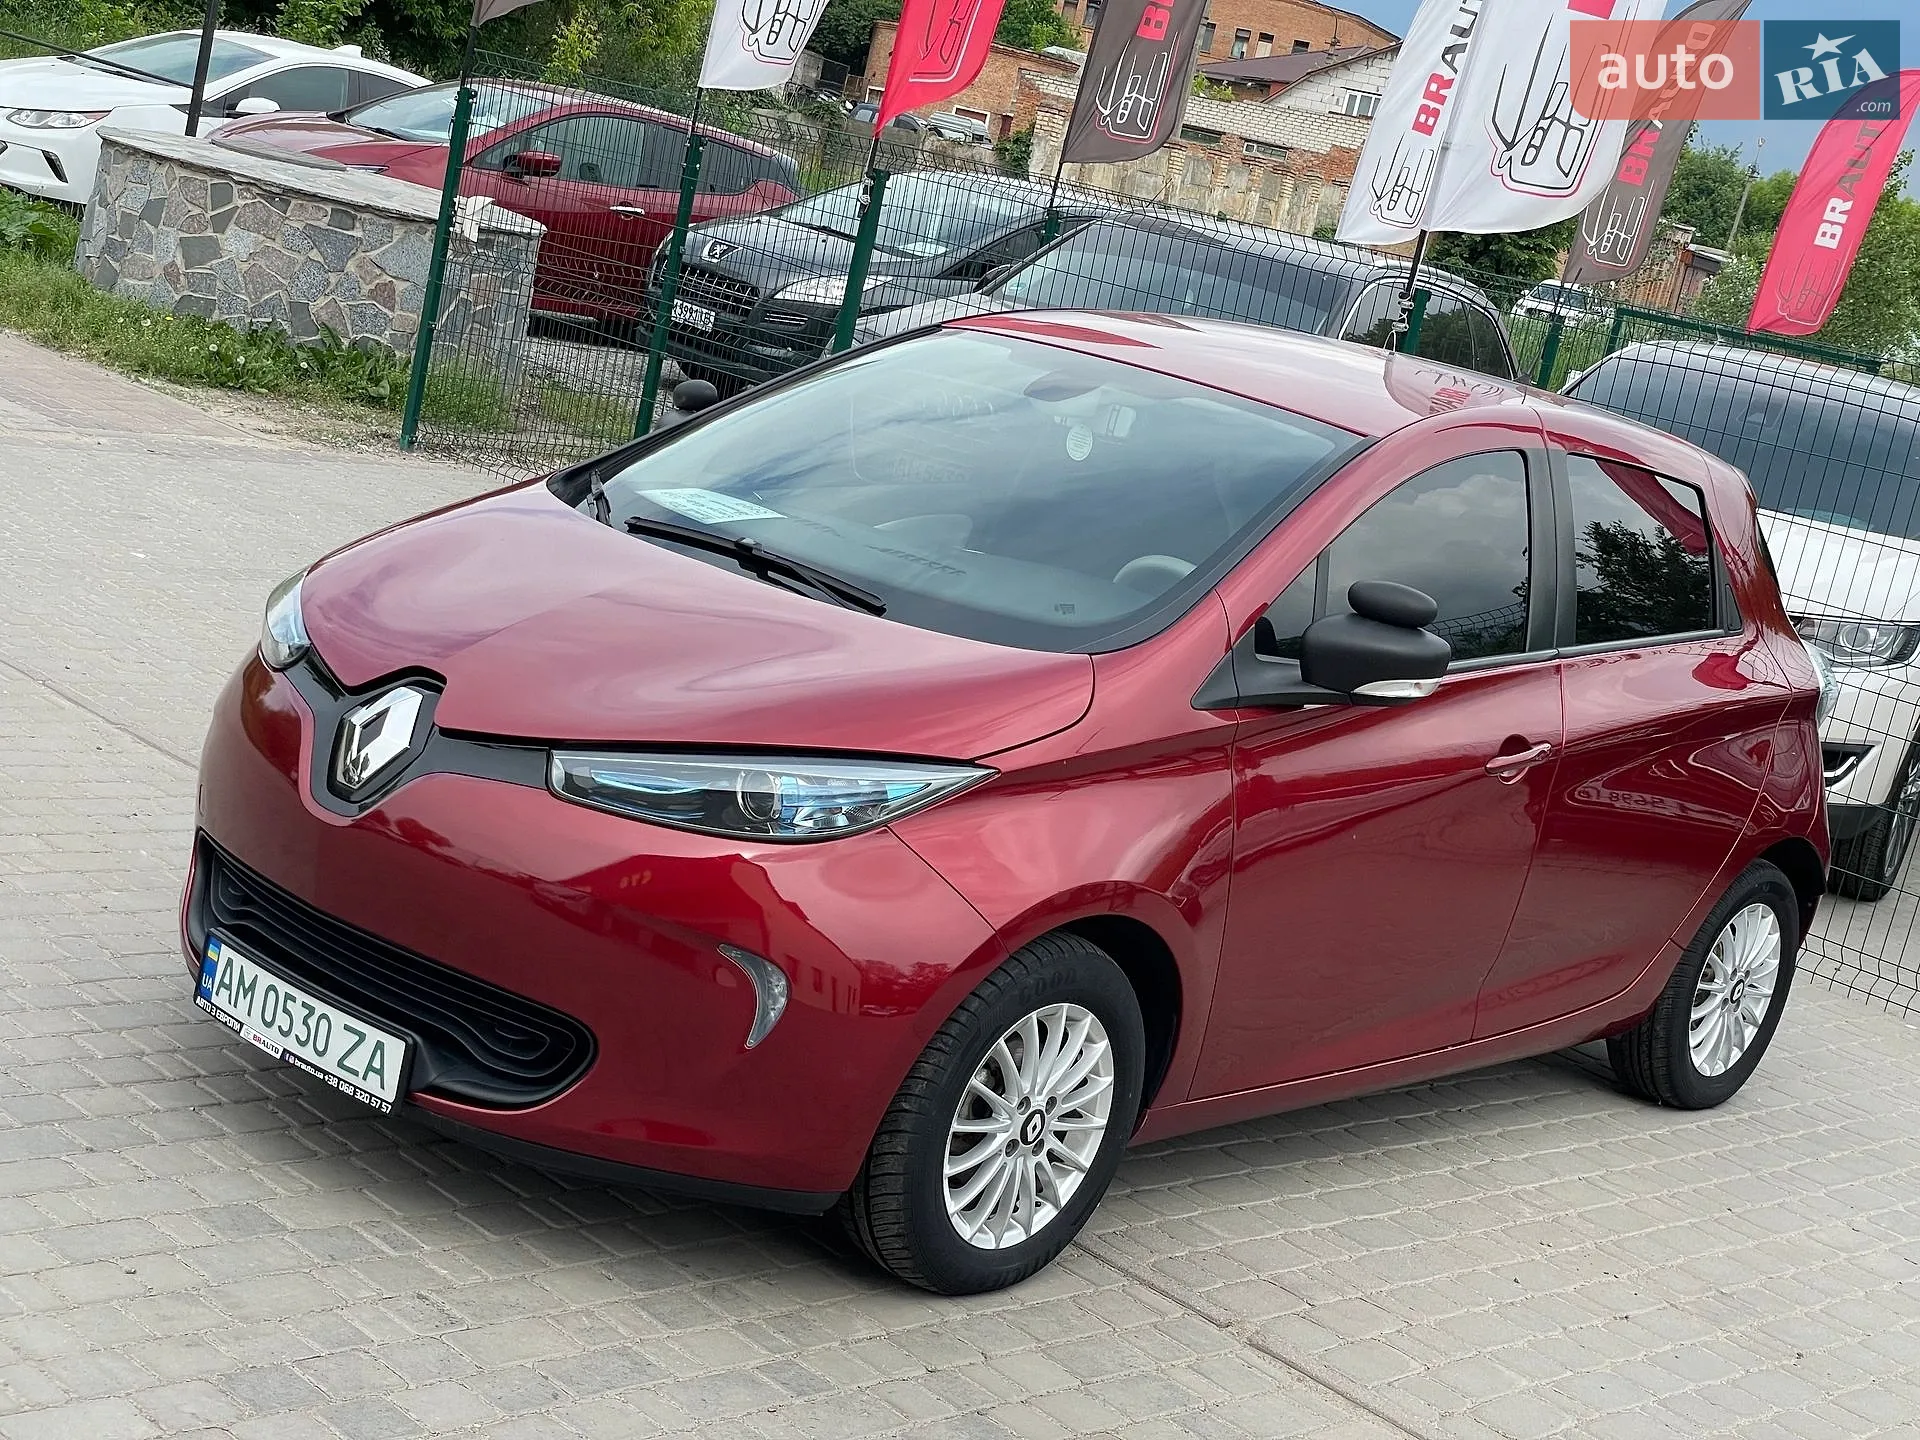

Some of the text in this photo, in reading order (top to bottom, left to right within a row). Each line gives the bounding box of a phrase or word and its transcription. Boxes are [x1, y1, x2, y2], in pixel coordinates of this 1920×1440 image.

[1136, 0, 1174, 41] B
[1411, 0, 1479, 137] BRAU
[201, 973, 213, 992] UA
[195, 995, 211, 1013] АВТО
[215, 956, 386, 1091] AM 0530 ZA
[252, 1033, 280, 1055] BRAUTO
[323, 1073, 338, 1088] +38
[338, 1080, 355, 1096] 068
[354, 1088, 370, 1104] 320
[370, 1096, 381, 1109] 57
[380, 1101, 392, 1114] 57
